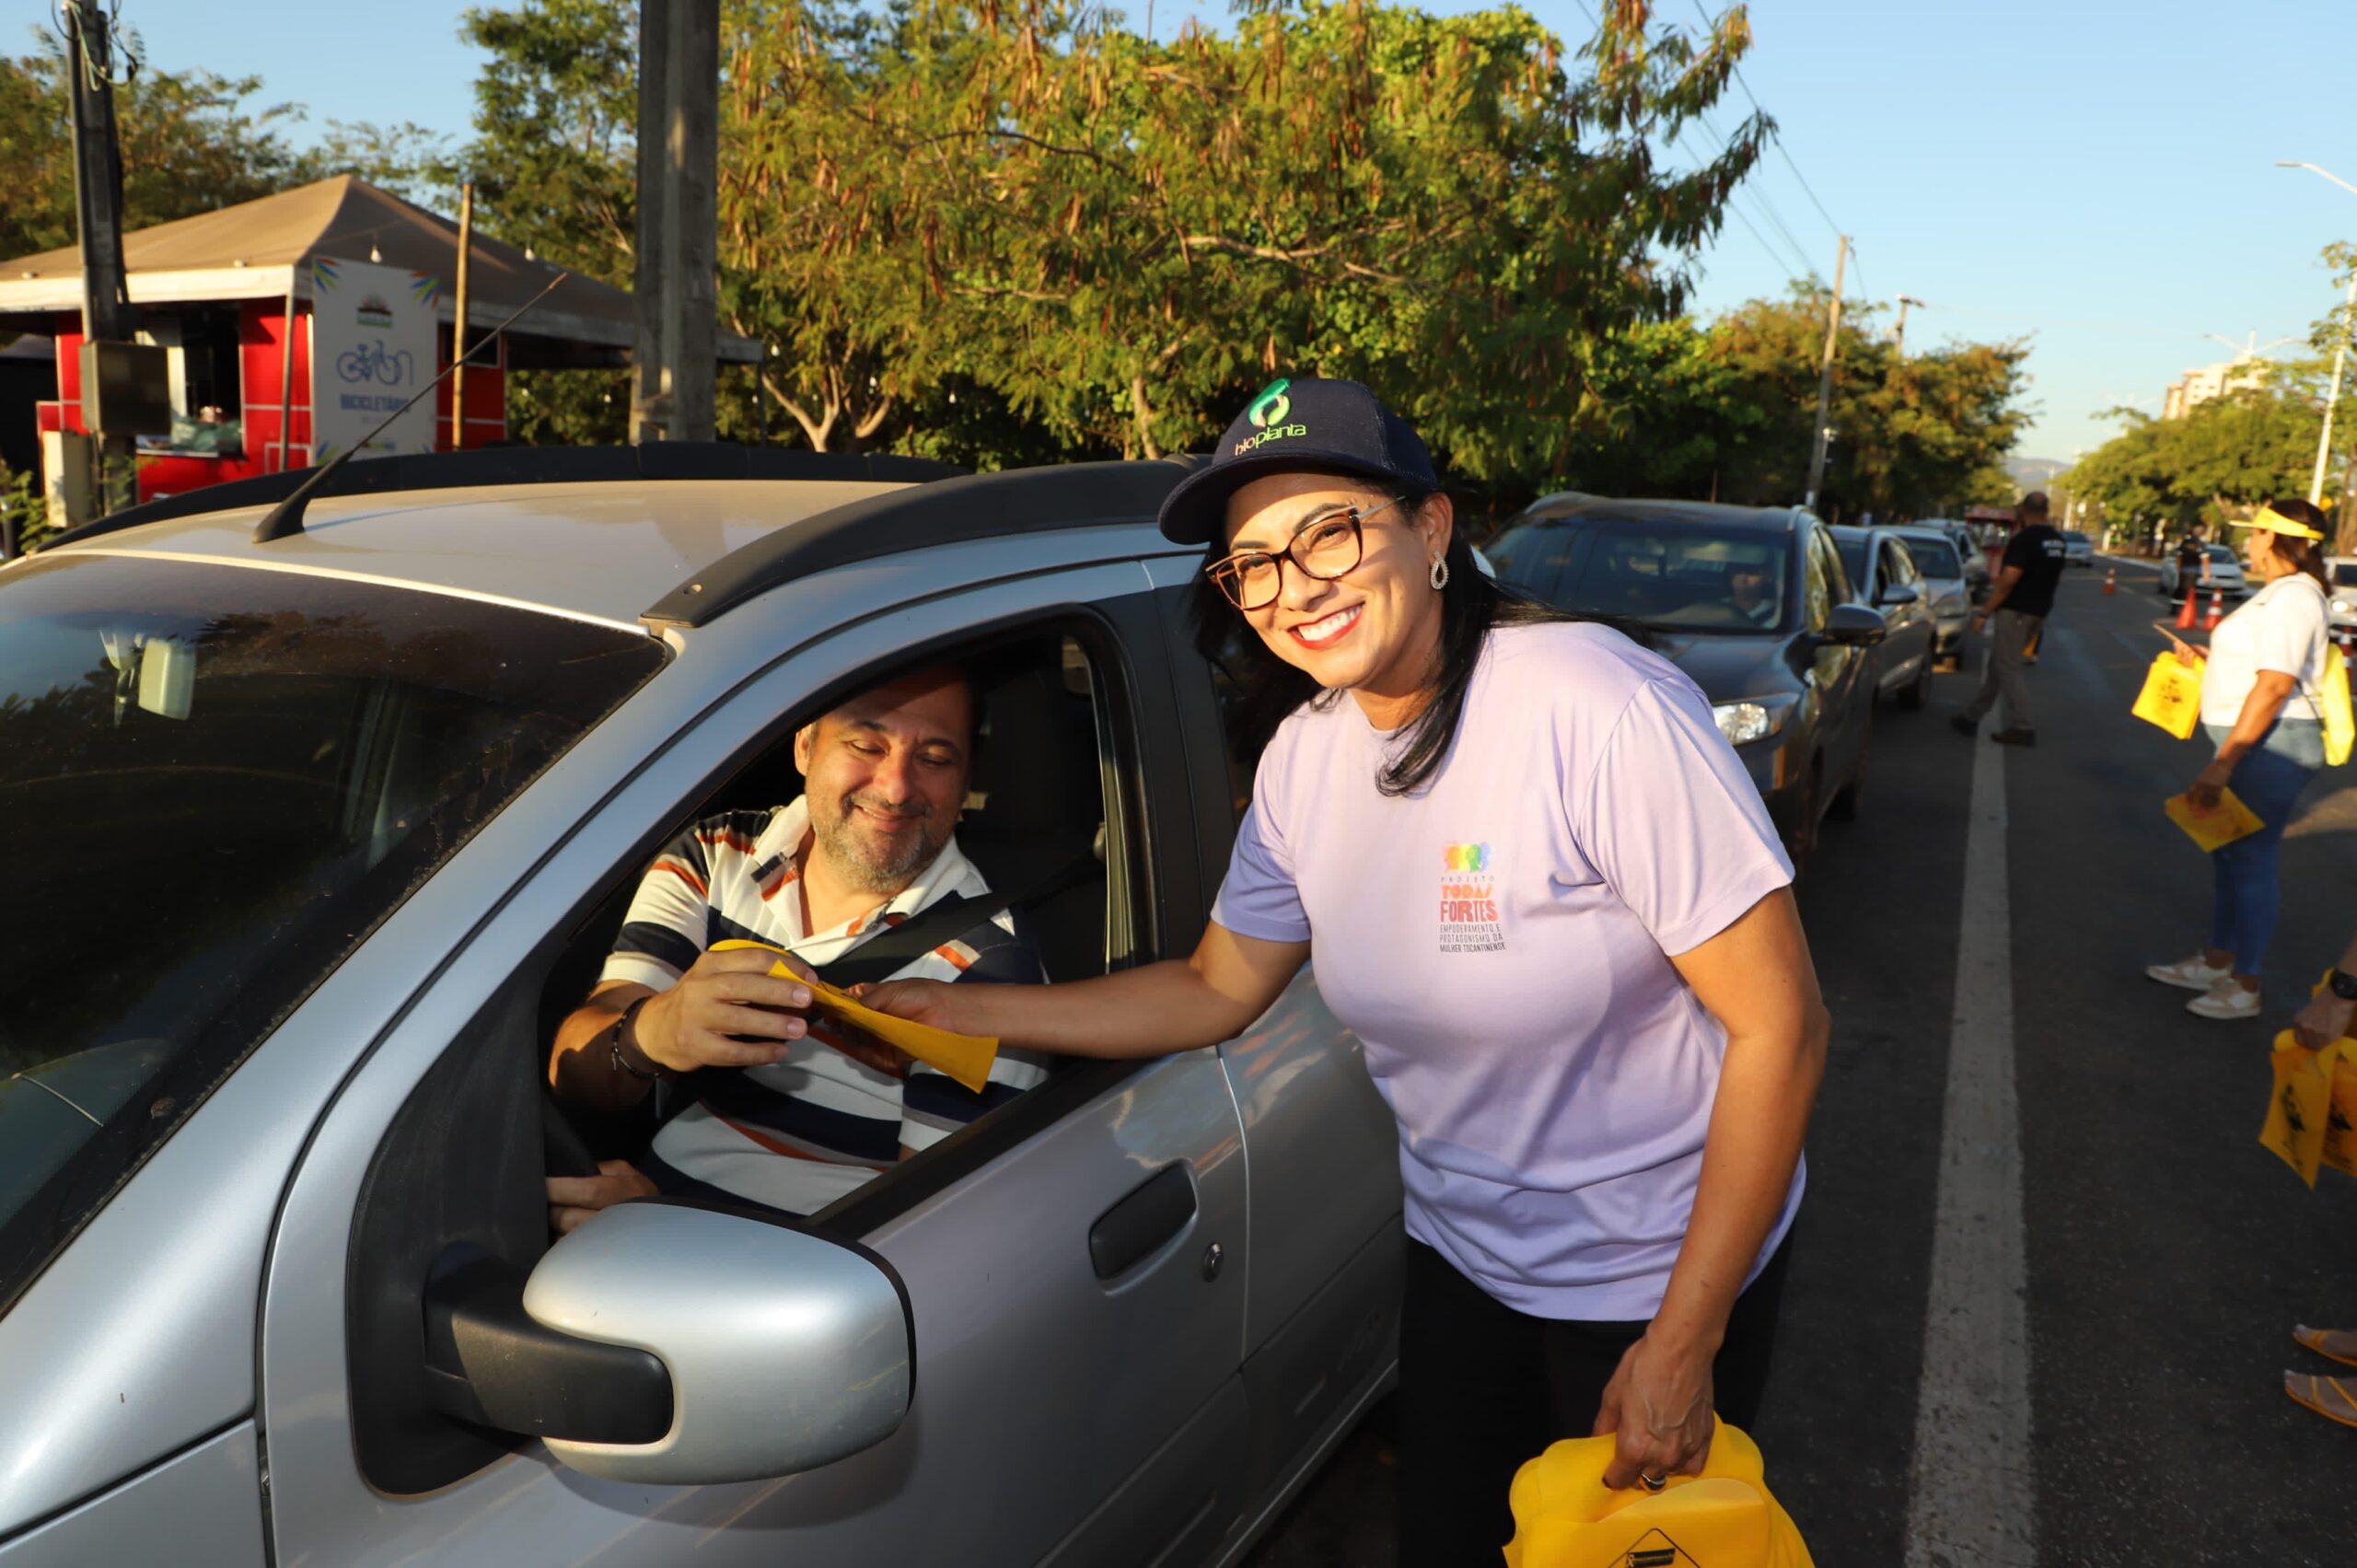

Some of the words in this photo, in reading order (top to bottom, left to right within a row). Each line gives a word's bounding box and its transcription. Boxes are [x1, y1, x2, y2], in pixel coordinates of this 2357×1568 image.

[1235, 424, 1306, 456] bioplanta
[1440, 900, 1498, 923] FORTES
[1440, 923, 1493, 934] EMPODERAMENTO
[1496, 923, 1501, 932] E
[1440, 934, 1490, 944] PROTAGONISMO
[1493, 933, 1503, 942] DA
[1440, 944, 1461, 953] MULHER
[1464, 942, 1506, 953] TOCANTINENSE
